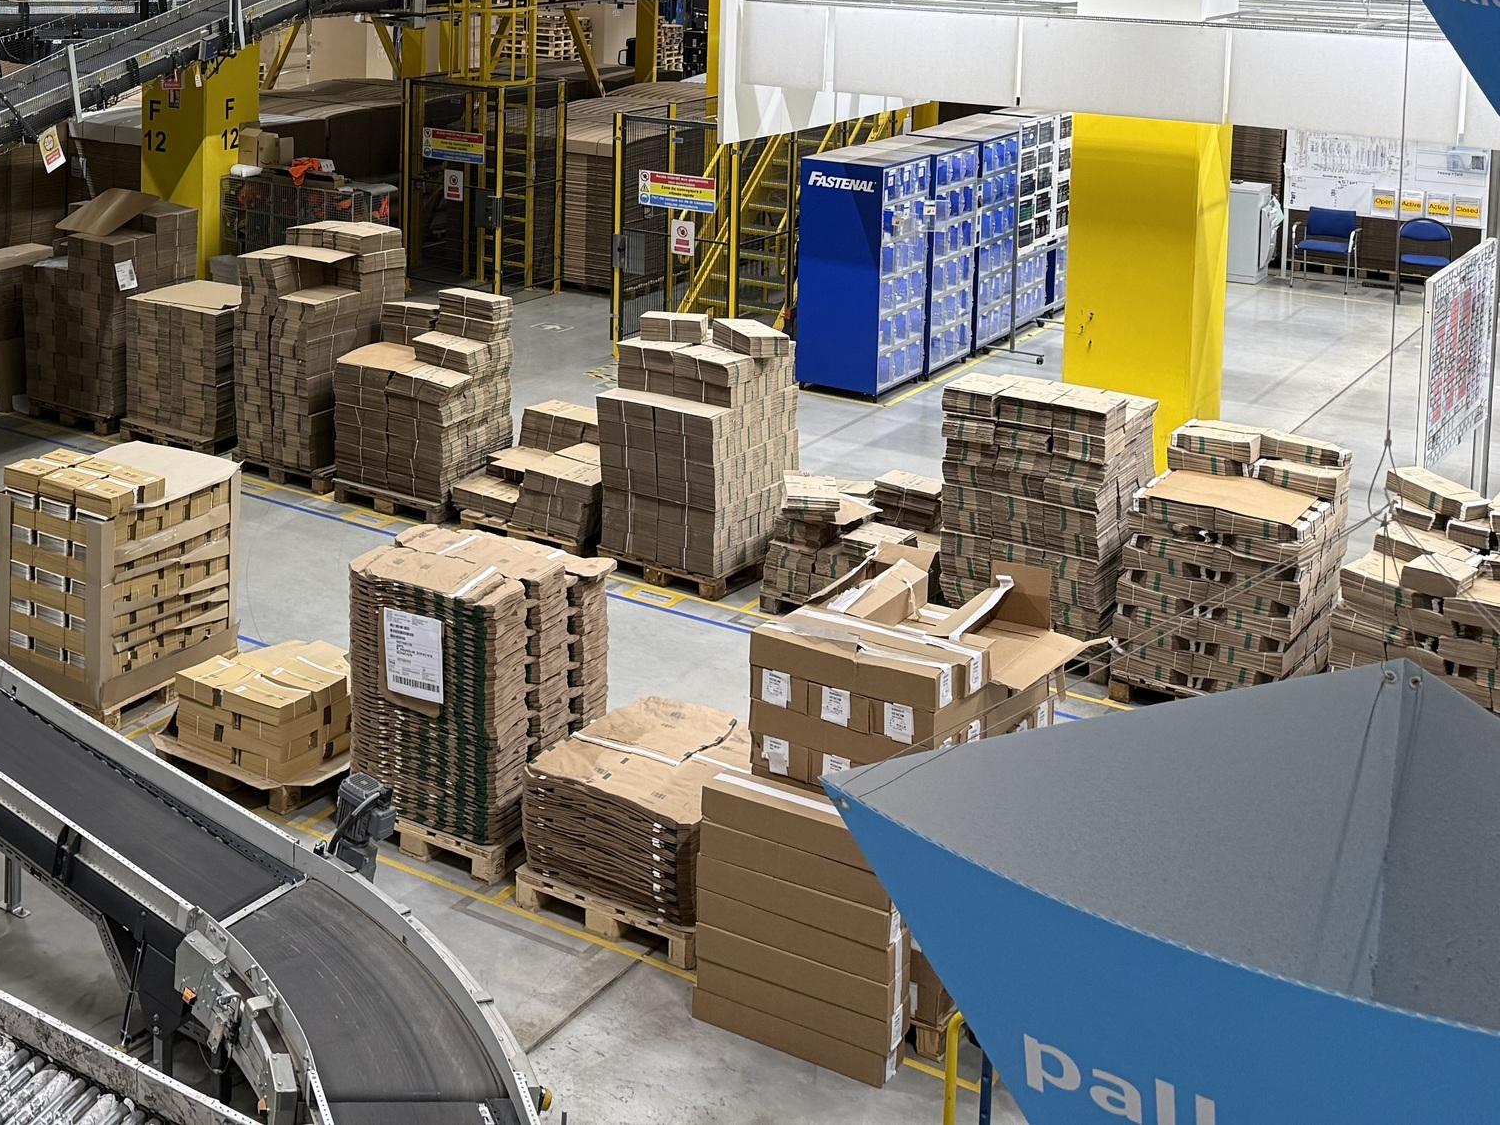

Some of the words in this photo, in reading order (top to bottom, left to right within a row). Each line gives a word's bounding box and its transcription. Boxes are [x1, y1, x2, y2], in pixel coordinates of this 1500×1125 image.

[149, 99, 161, 122] F
[225, 97, 236, 120] F
[143, 129, 167, 153] 12
[221, 127, 240, 151] 12
[1375, 197, 1393, 207] Open
[1402, 200, 1421, 208] Active
[1428, 203, 1449, 211] Active
[1455, 205, 1479, 214] Closed
